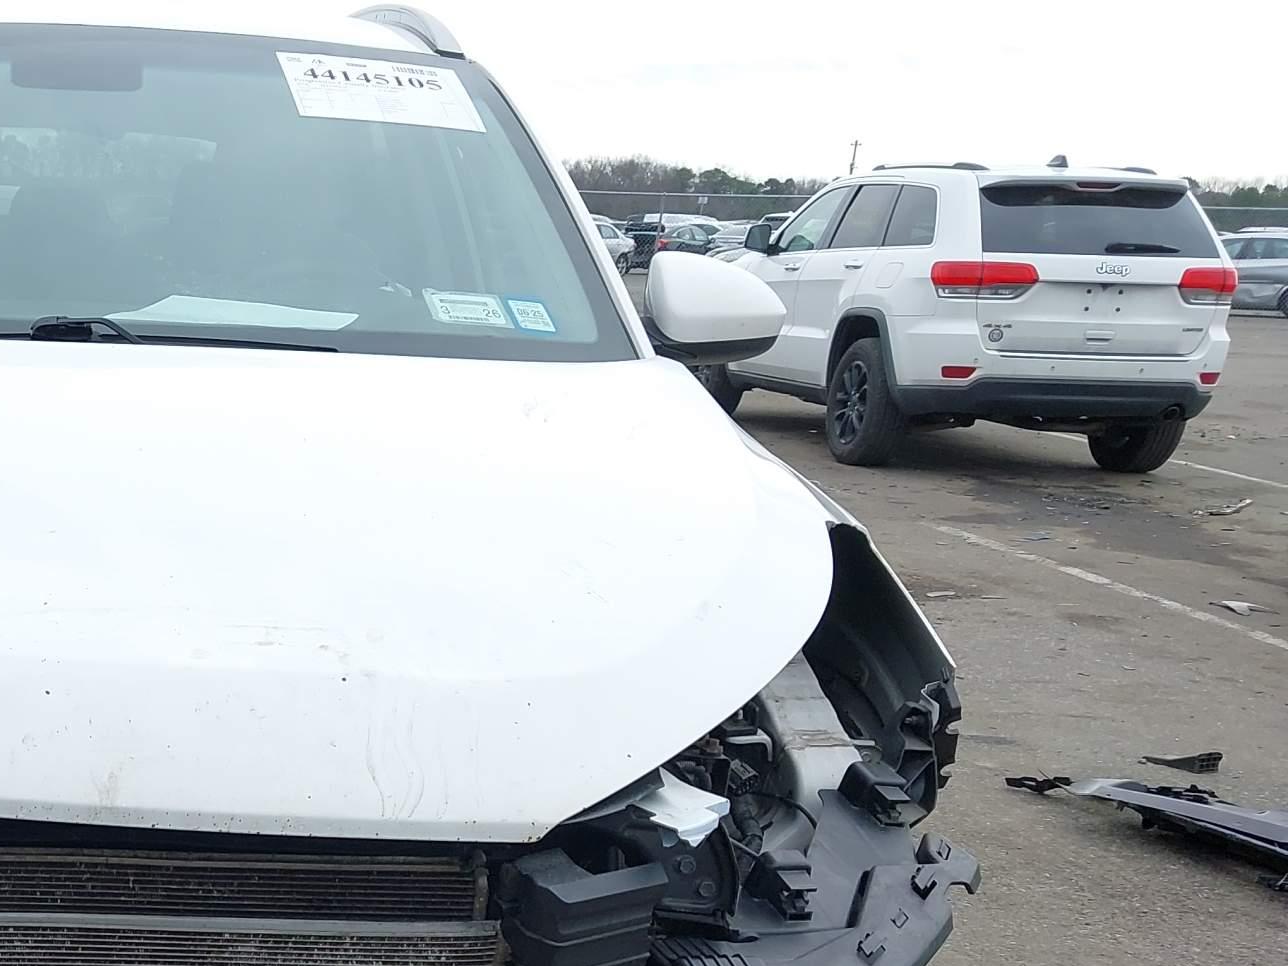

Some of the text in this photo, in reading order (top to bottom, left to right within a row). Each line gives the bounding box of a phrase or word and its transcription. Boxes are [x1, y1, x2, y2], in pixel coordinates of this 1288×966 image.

[303, 67, 443, 92] 44145105
[1096, 261, 1131, 278] Jeep
[482, 308, 502, 319] 26
